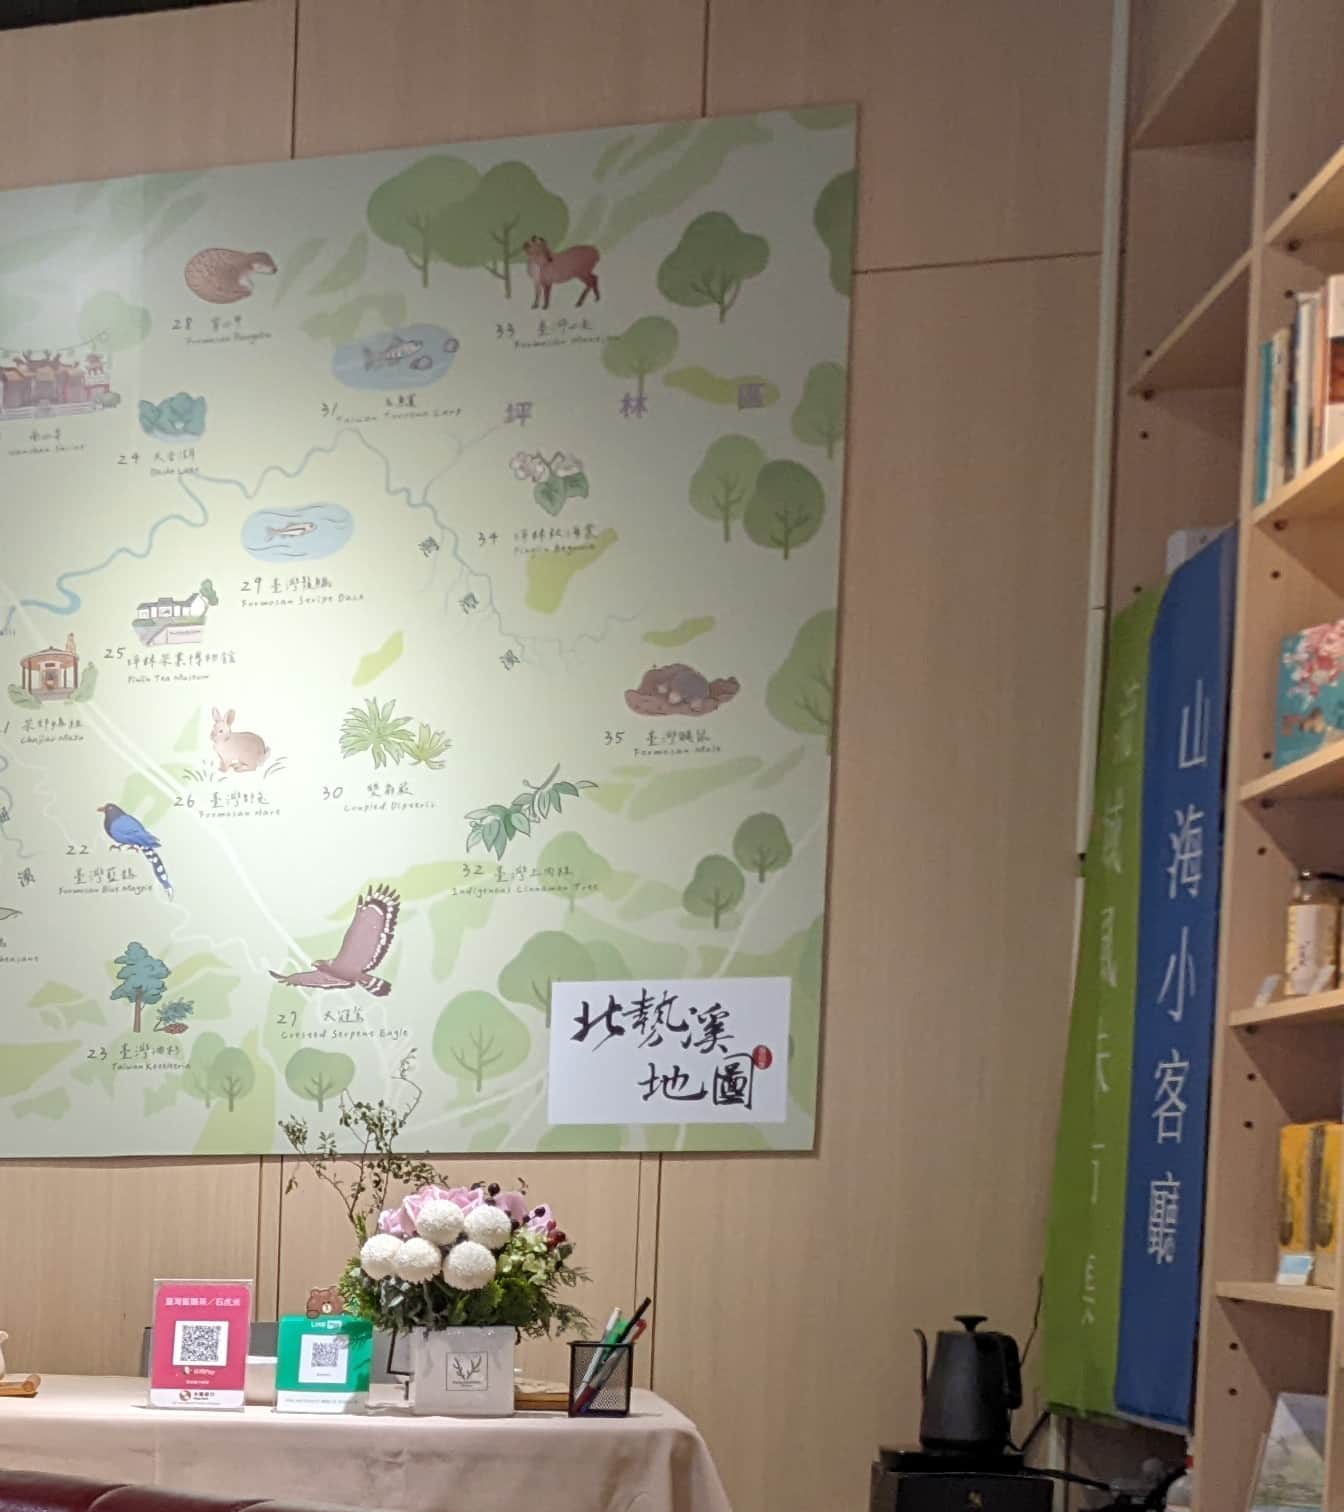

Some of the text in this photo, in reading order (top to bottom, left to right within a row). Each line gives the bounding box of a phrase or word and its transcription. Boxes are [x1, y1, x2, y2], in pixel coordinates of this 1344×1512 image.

[171, 316, 193, 330] 28
[496, 321, 515, 338] 33
[320, 401, 338, 417] 31
[618, 391, 648, 419] 林
[116, 451, 140, 464] 24
[478, 531, 498, 546] 34
[240, 576, 262, 595] 29
[103, 646, 126, 660] 25
[604, 730, 625, 746] 35
[173, 793, 196, 808] 26
[322, 786, 344, 801] 30
[65, 844, 89, 856] 22
[462, 863, 485, 878] 32
[1146, 679, 1211, 1264] 山海小客廳
[276, 1010, 297, 1028] 27
[87, 1046, 108, 1061] 23
[637, 1052, 755, 1111] 地圖
